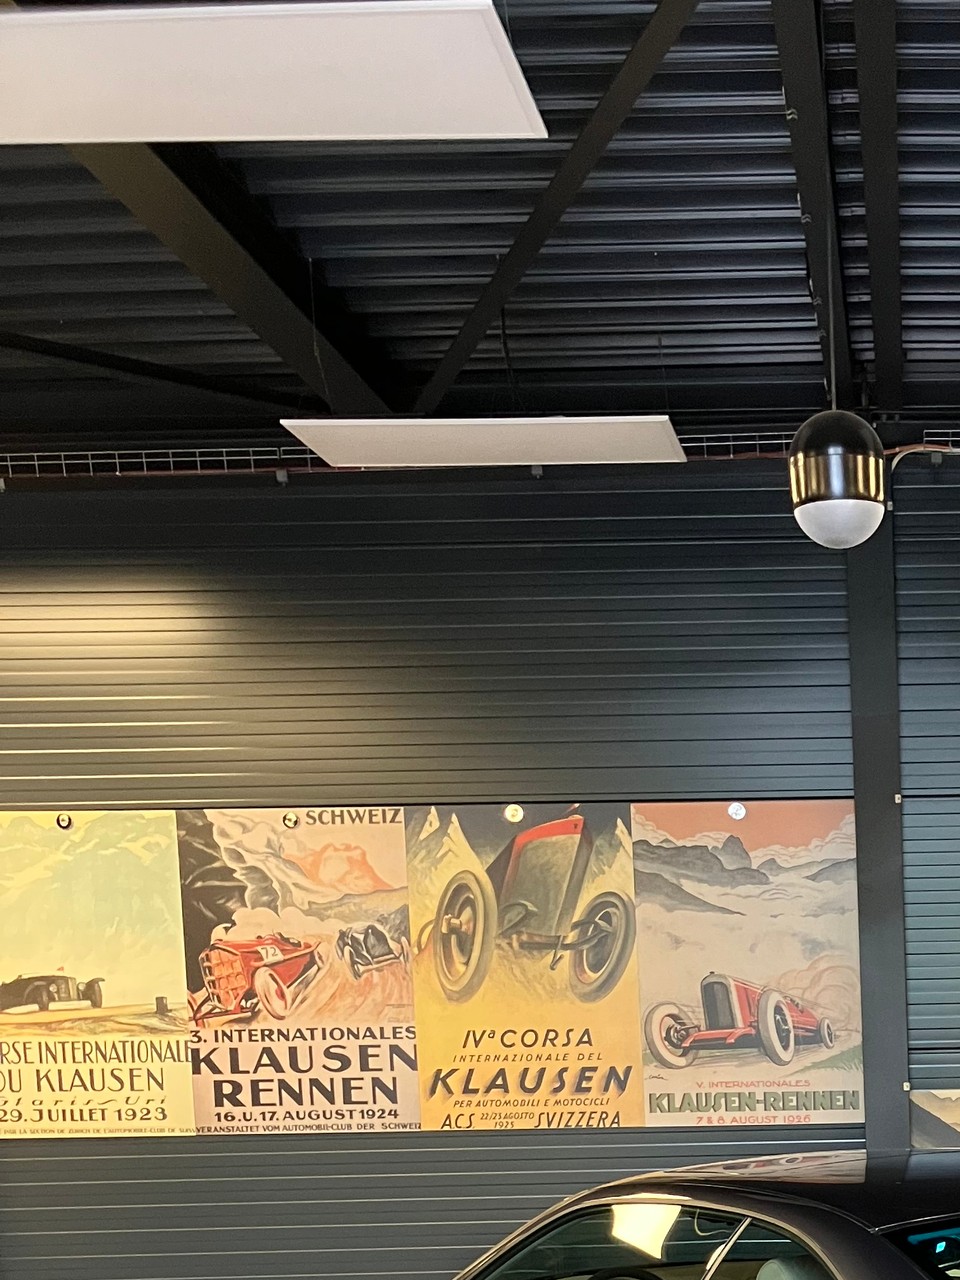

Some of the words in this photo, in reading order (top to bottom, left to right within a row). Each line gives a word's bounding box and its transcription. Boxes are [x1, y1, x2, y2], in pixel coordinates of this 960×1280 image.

[306, 808, 403, 826] SCHWEIZ
[260, 946, 279, 960] 72
[190, 1030, 208, 1044] 3.
[214, 1026, 417, 1043] INTERNATIONALES
[500, 1028, 593, 1048] CORSA
[38, 1040, 192, 1064] INTERNATIONALE
[191, 1044, 419, 1076] KLAUSEN
[453, 1052, 569, 1063] INTERNAZIONALE
[577, 1052, 603, 1061] DEL
[36, 1067, 165, 1093] KLAUSEN
[429, 1065, 633, 1098] KLAUSEN
[709, 1079, 811, 1089] INTERNATIONALES
[213, 1076, 398, 1107] RENNEN
[453, 1100, 473, 1108] PER
[475, 1099, 540, 1107] AUTOMOBILI
[544, 1098, 550, 1107] E
[553, 1098, 610, 1107] MOTOCICLI
[649, 1090, 860, 1113] KLAUSEN-RENNEN
[30, 1108, 109, 1122] JUILLET
[114, 1107, 168, 1121] 1923
[283, 1109, 357, 1121] AUGUST
[358, 1108, 400, 1120] 1924
[503, 1112, 535, 1120] AGOSTO
[534, 1111, 621, 1128] SVIZZERA
[695, 1116, 704, 1125] 7
[706, 1116, 714, 1125] &
[730, 1115, 779, 1125] AUGUST
[783, 1114, 811, 1124] 1926
[195, 1125, 260, 1134] VERANSTALTET
[357, 1123, 375, 1131] DER
[381, 1122, 421, 1130] SCHWEIZ
[494, 1121, 515, 1129] 1925
